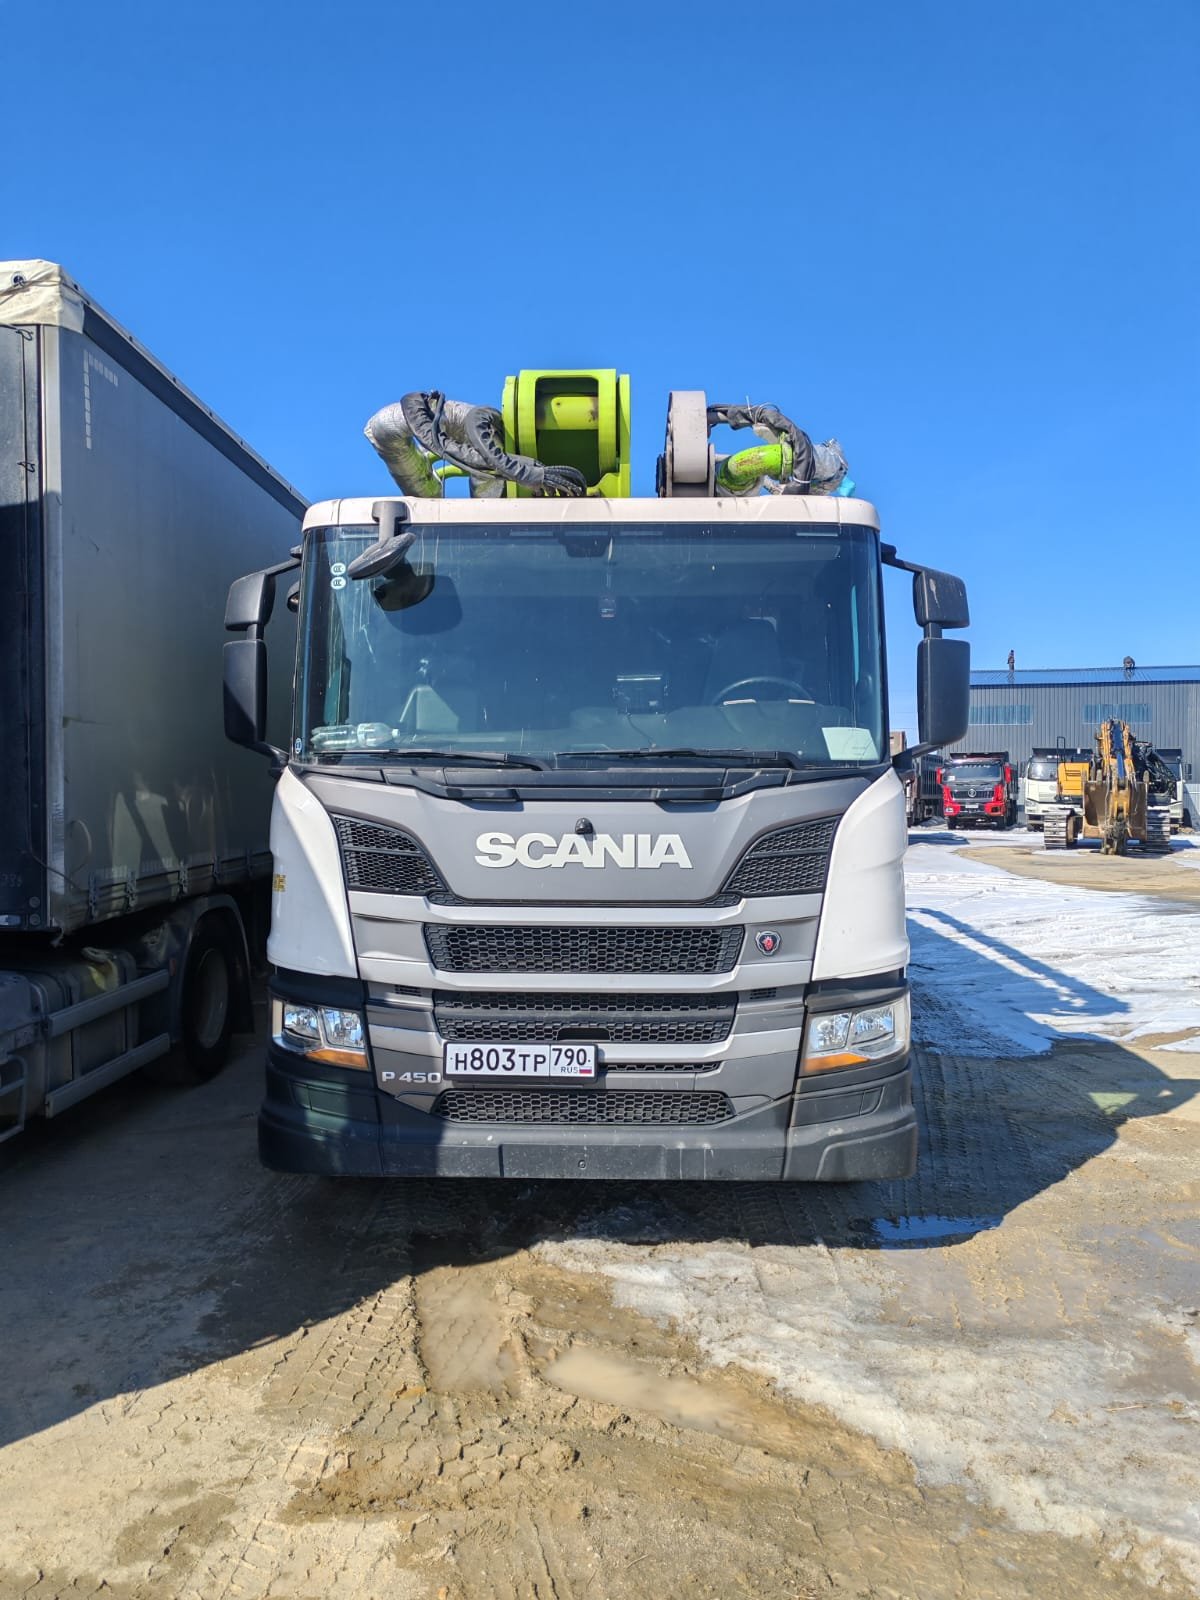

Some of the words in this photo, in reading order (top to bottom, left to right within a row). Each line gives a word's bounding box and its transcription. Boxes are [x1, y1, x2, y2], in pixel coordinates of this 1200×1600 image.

[474, 832, 693, 869] SCANIA
[552, 1048, 587, 1066] 790
[381, 1071, 396, 1082] P
[398, 1072, 441, 1084] 450
[560, 1066, 578, 1074] RUS
